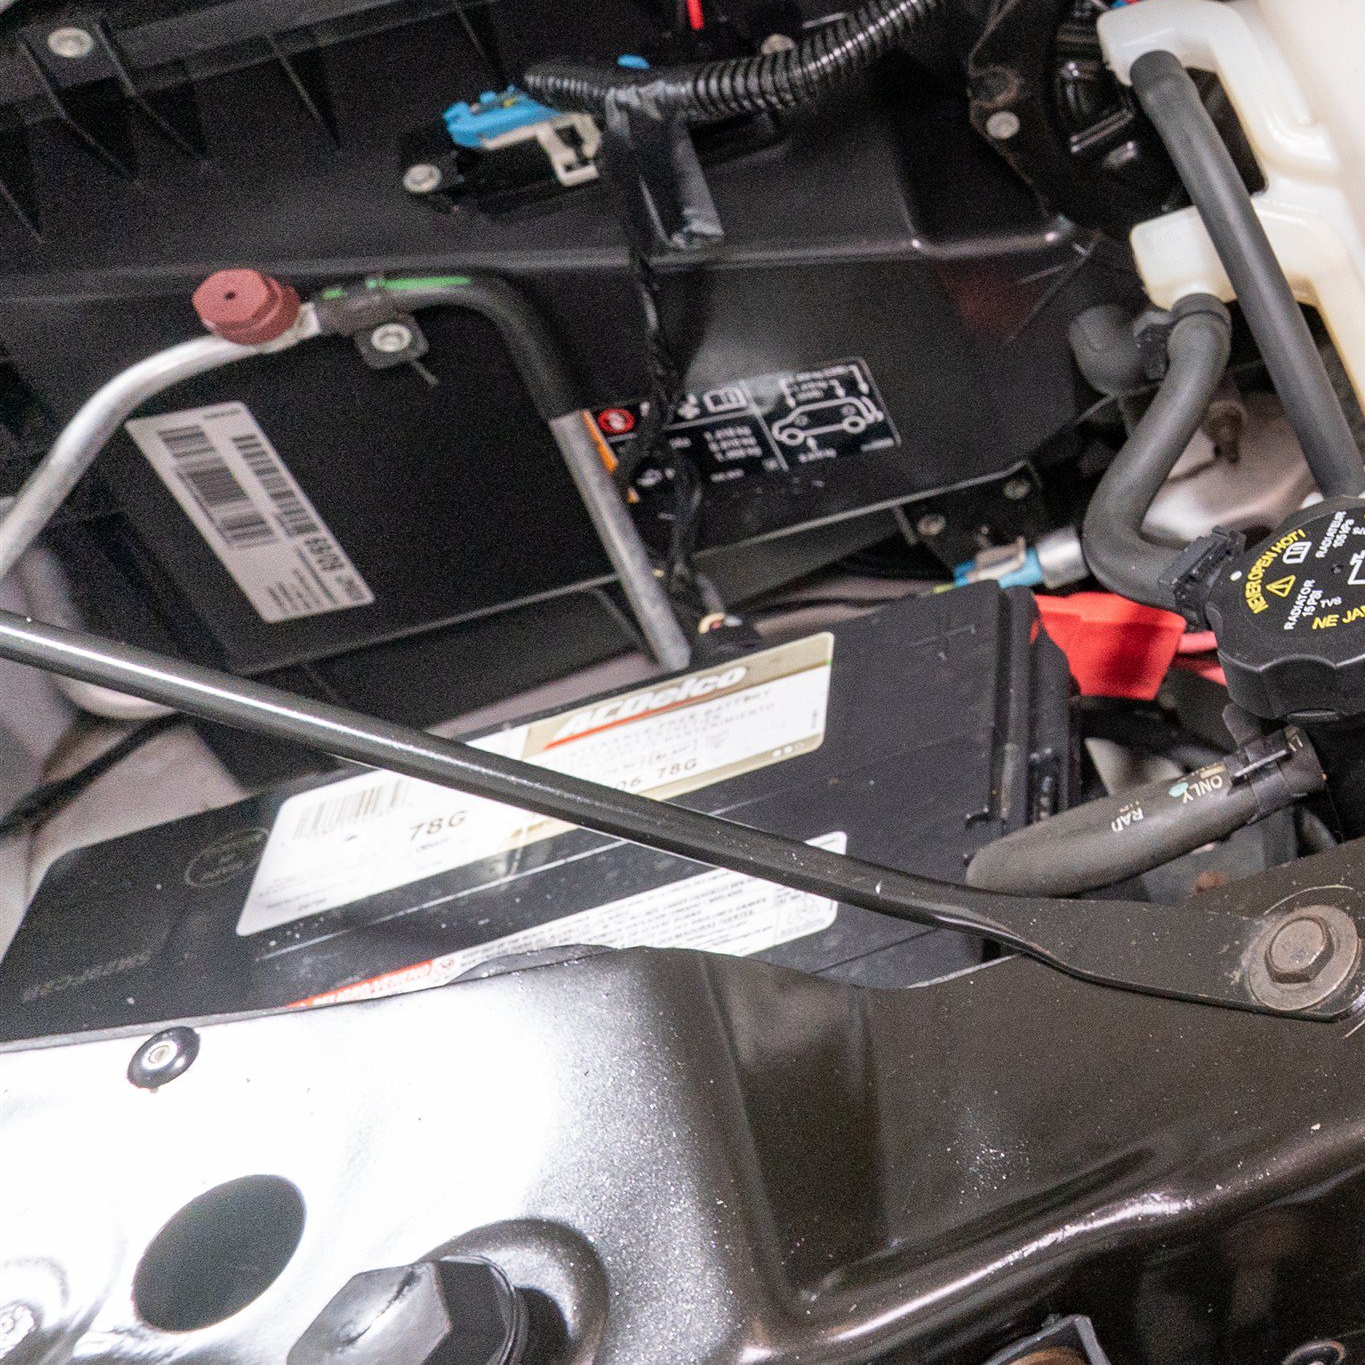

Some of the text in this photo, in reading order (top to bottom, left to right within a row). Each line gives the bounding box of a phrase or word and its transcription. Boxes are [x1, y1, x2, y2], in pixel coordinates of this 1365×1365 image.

[1315, 511, 1347, 558] RADIATEUR
[1248, 551, 1278, 582] OPEN
[1245, 579, 1269, 614] NEVER
[1283, 579, 1316, 631] RADIATOR
[1301, 588, 1324, 617] 15 PSI
[1311, 614, 1340, 630] NE
[552, 666, 748, 741] ACDelco
[657, 758, 699, 781] 78G
[1182, 773, 1225, 805] ONLY
[408, 810, 469, 843] 78G
